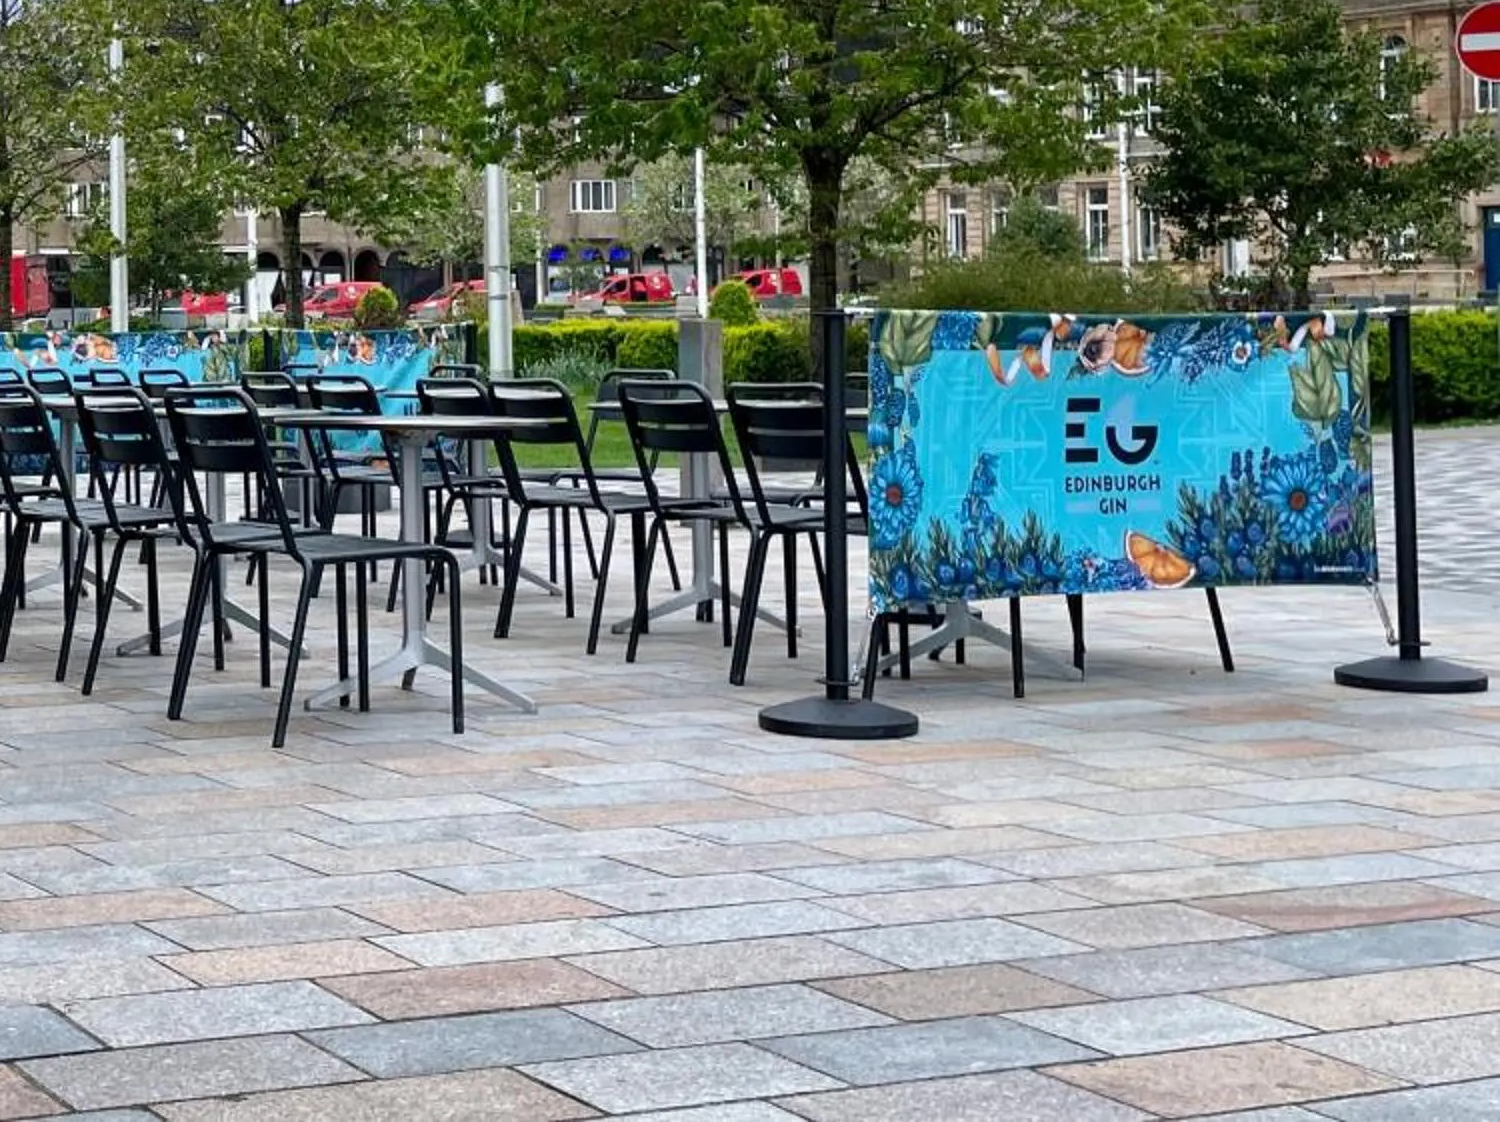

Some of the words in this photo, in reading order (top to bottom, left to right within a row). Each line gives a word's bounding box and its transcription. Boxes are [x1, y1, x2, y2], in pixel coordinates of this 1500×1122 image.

[1064, 396, 1159, 465] EG
[1064, 475, 1161, 494] EDINBURGH
[1099, 498, 1128, 515] GIN
